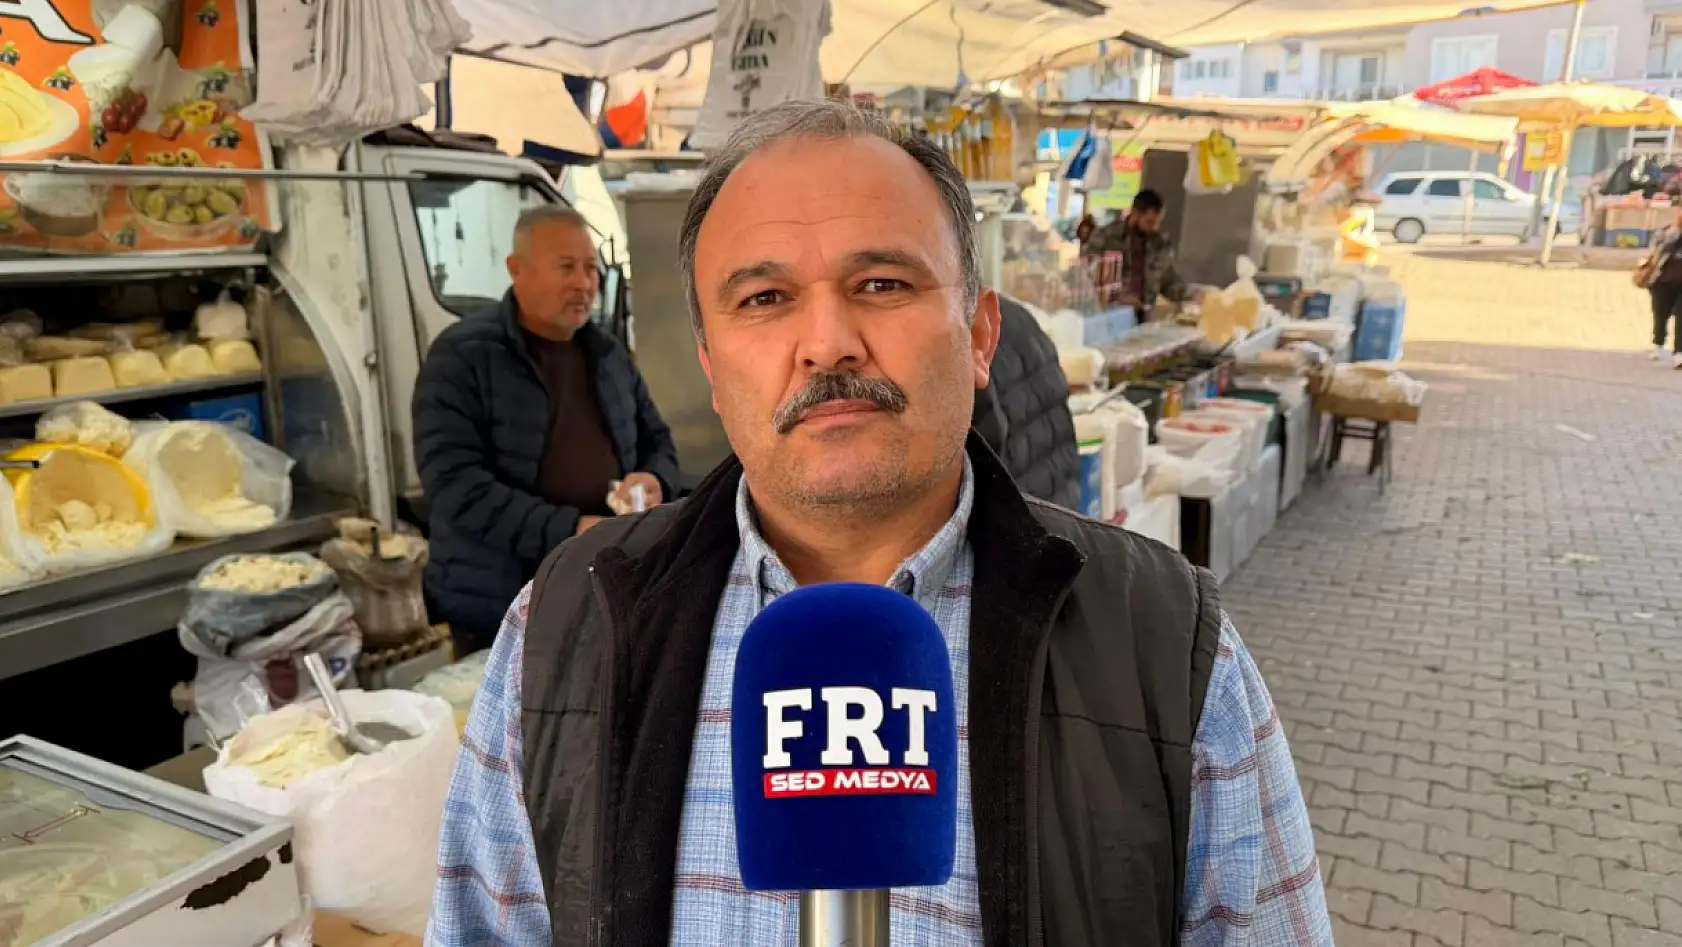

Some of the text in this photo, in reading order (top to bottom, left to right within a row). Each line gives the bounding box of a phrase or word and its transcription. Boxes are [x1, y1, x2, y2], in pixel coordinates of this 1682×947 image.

[763, 686, 937, 769] FRT
[770, 771, 931, 792] SED MEDYA
